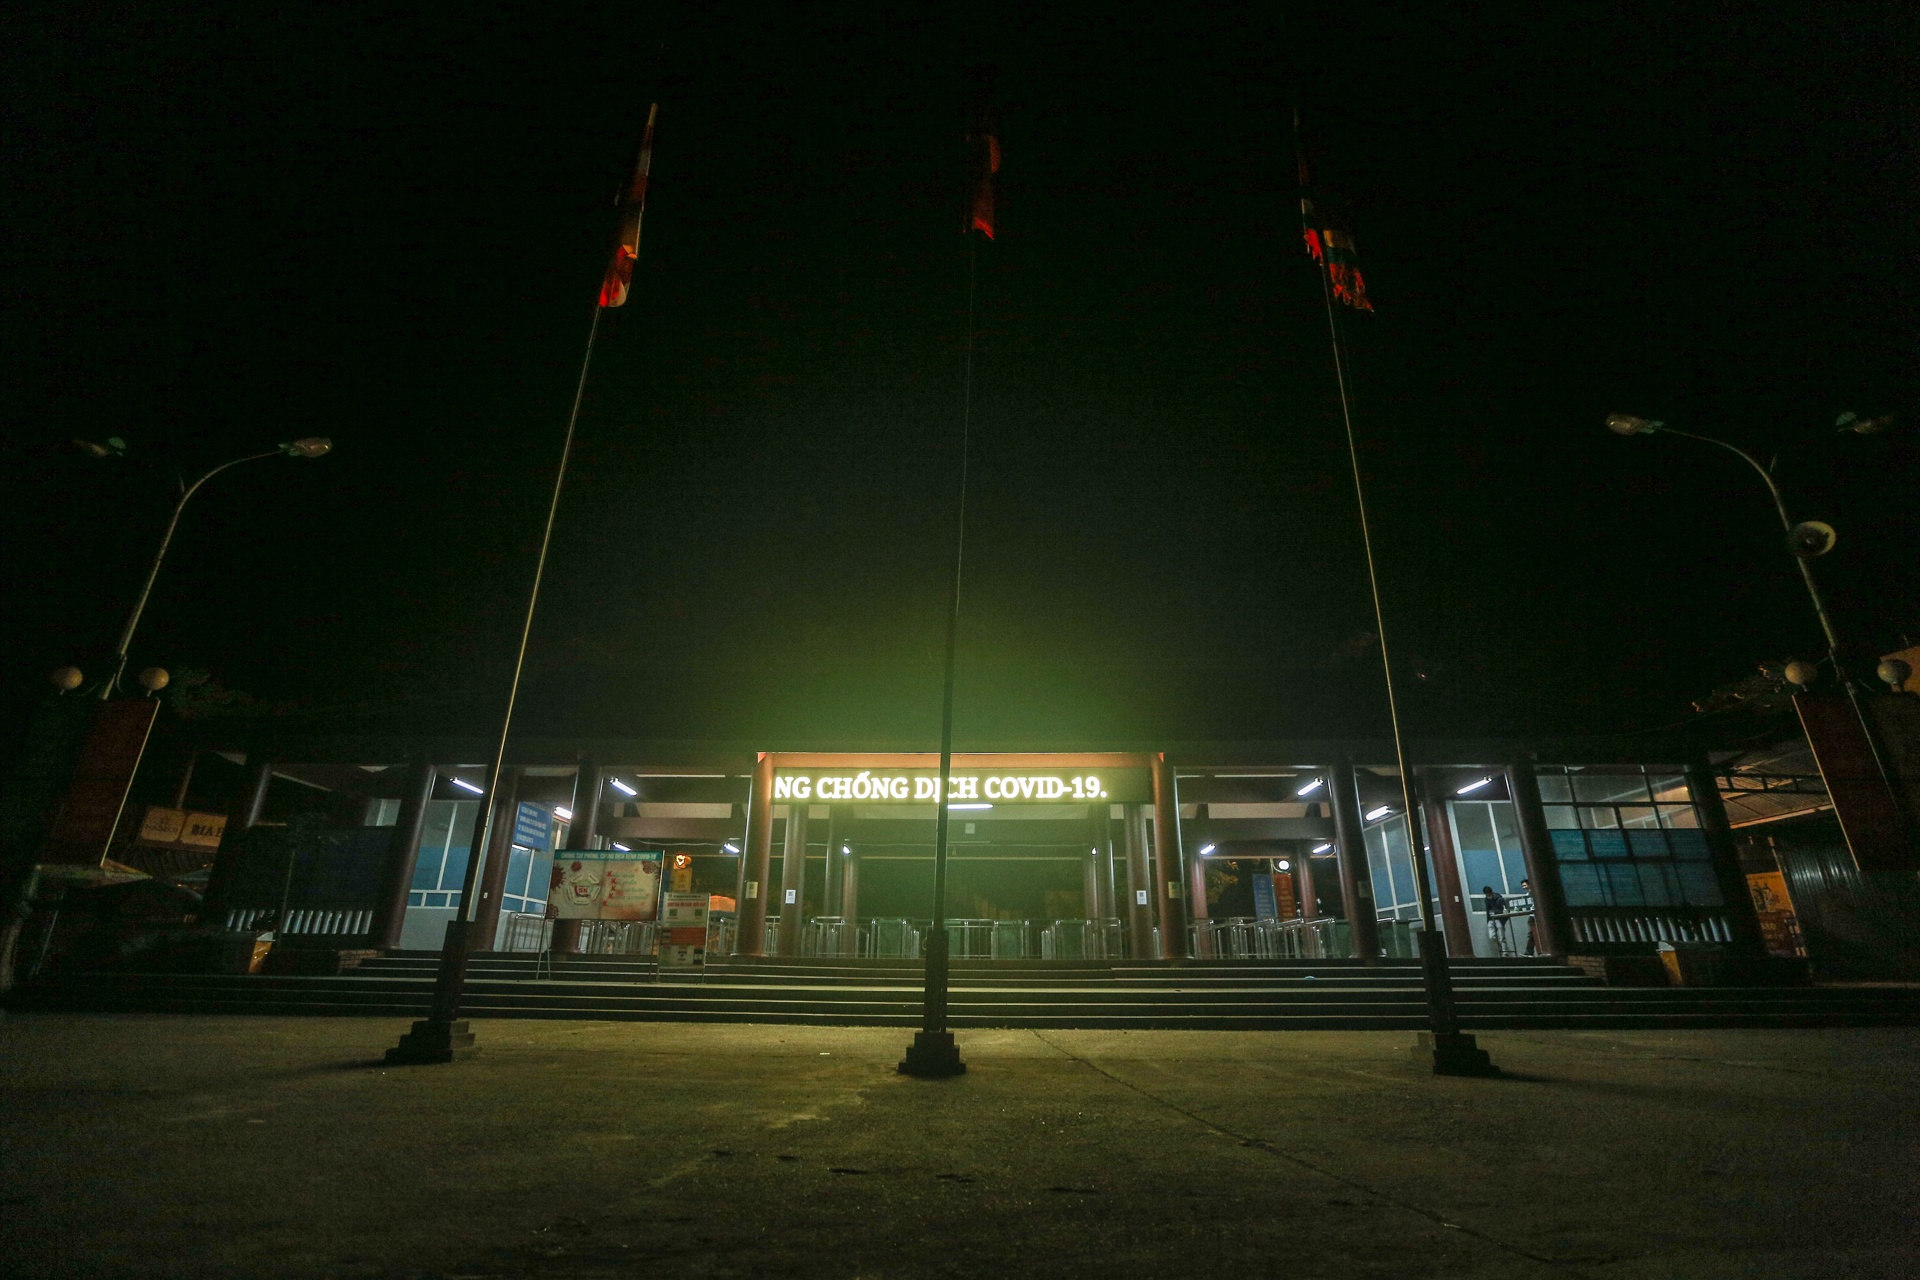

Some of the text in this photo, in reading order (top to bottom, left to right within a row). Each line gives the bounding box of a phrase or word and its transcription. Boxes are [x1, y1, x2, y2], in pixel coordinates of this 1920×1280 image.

[774, 770, 1107, 803] NG CHỐNG DỊCH COVID-19.
